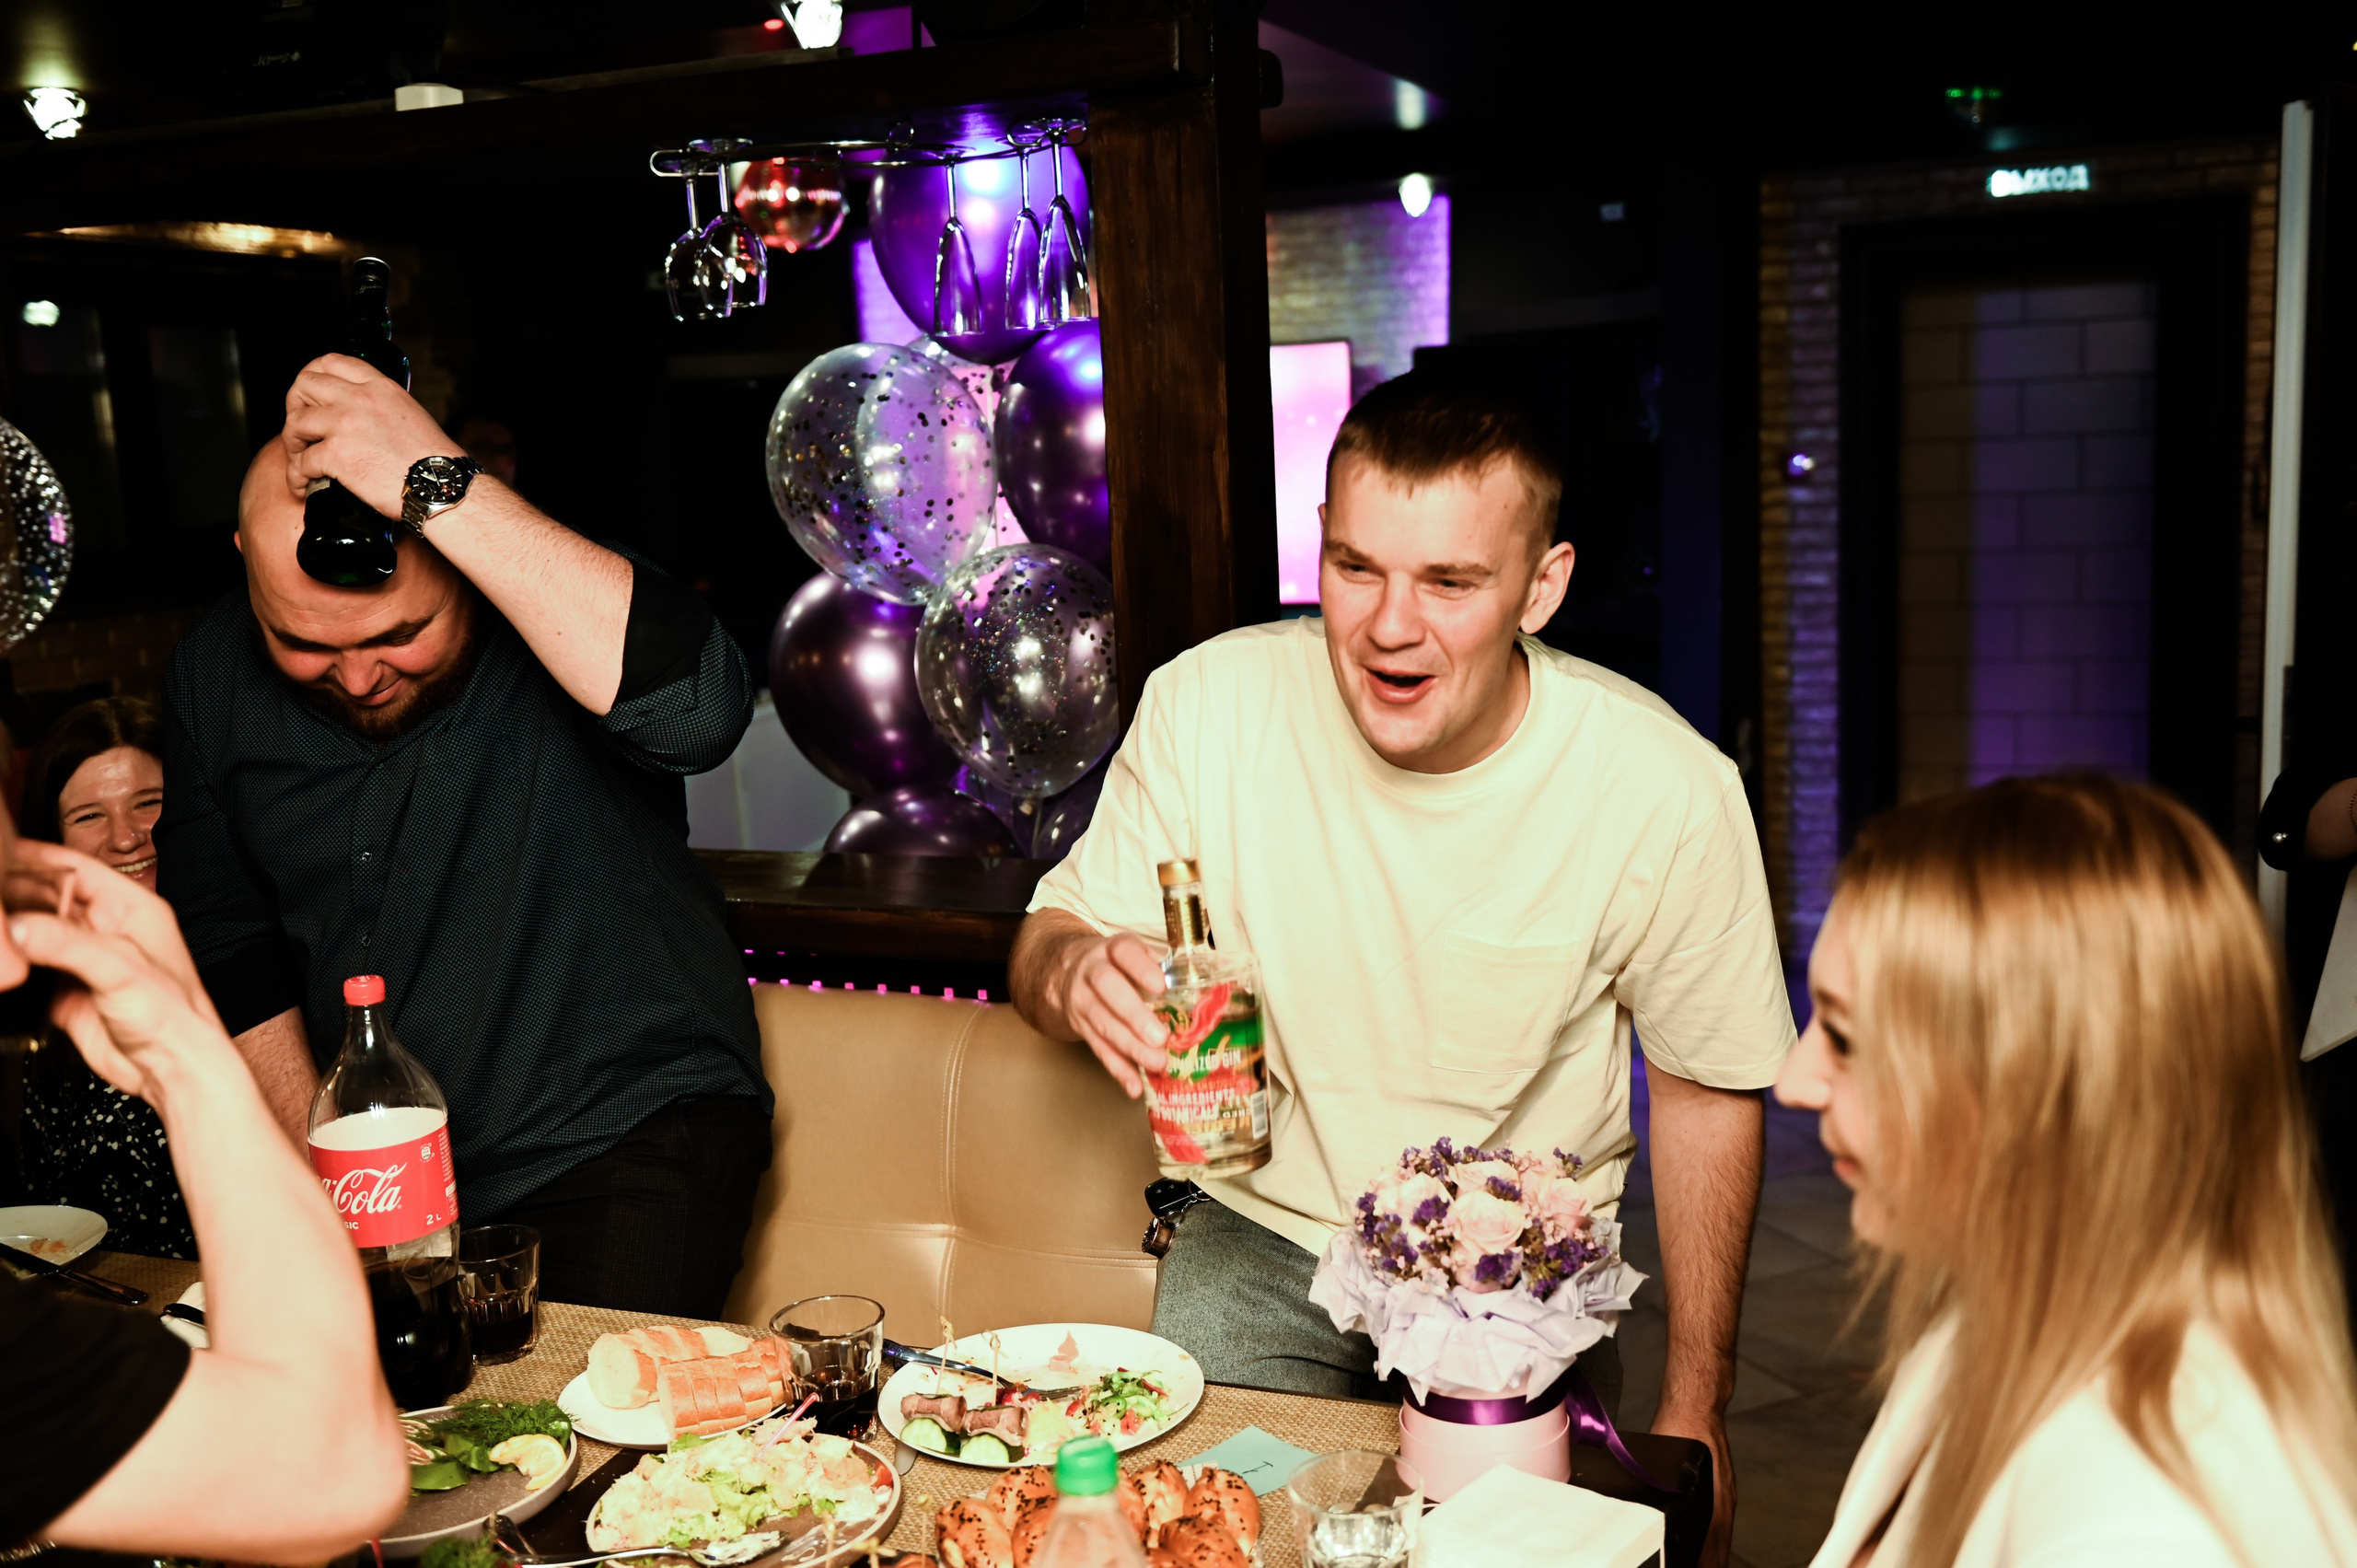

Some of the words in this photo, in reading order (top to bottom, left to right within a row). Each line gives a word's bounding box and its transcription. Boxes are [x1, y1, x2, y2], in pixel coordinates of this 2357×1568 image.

[1223, 1050, 1241, 1068] GIN
[1169, 1087, 1235, 1106] INGREDIENTS
[318, 1162, 408, 1214] a-Cola
[426, 1214, 434, 1225] 2
